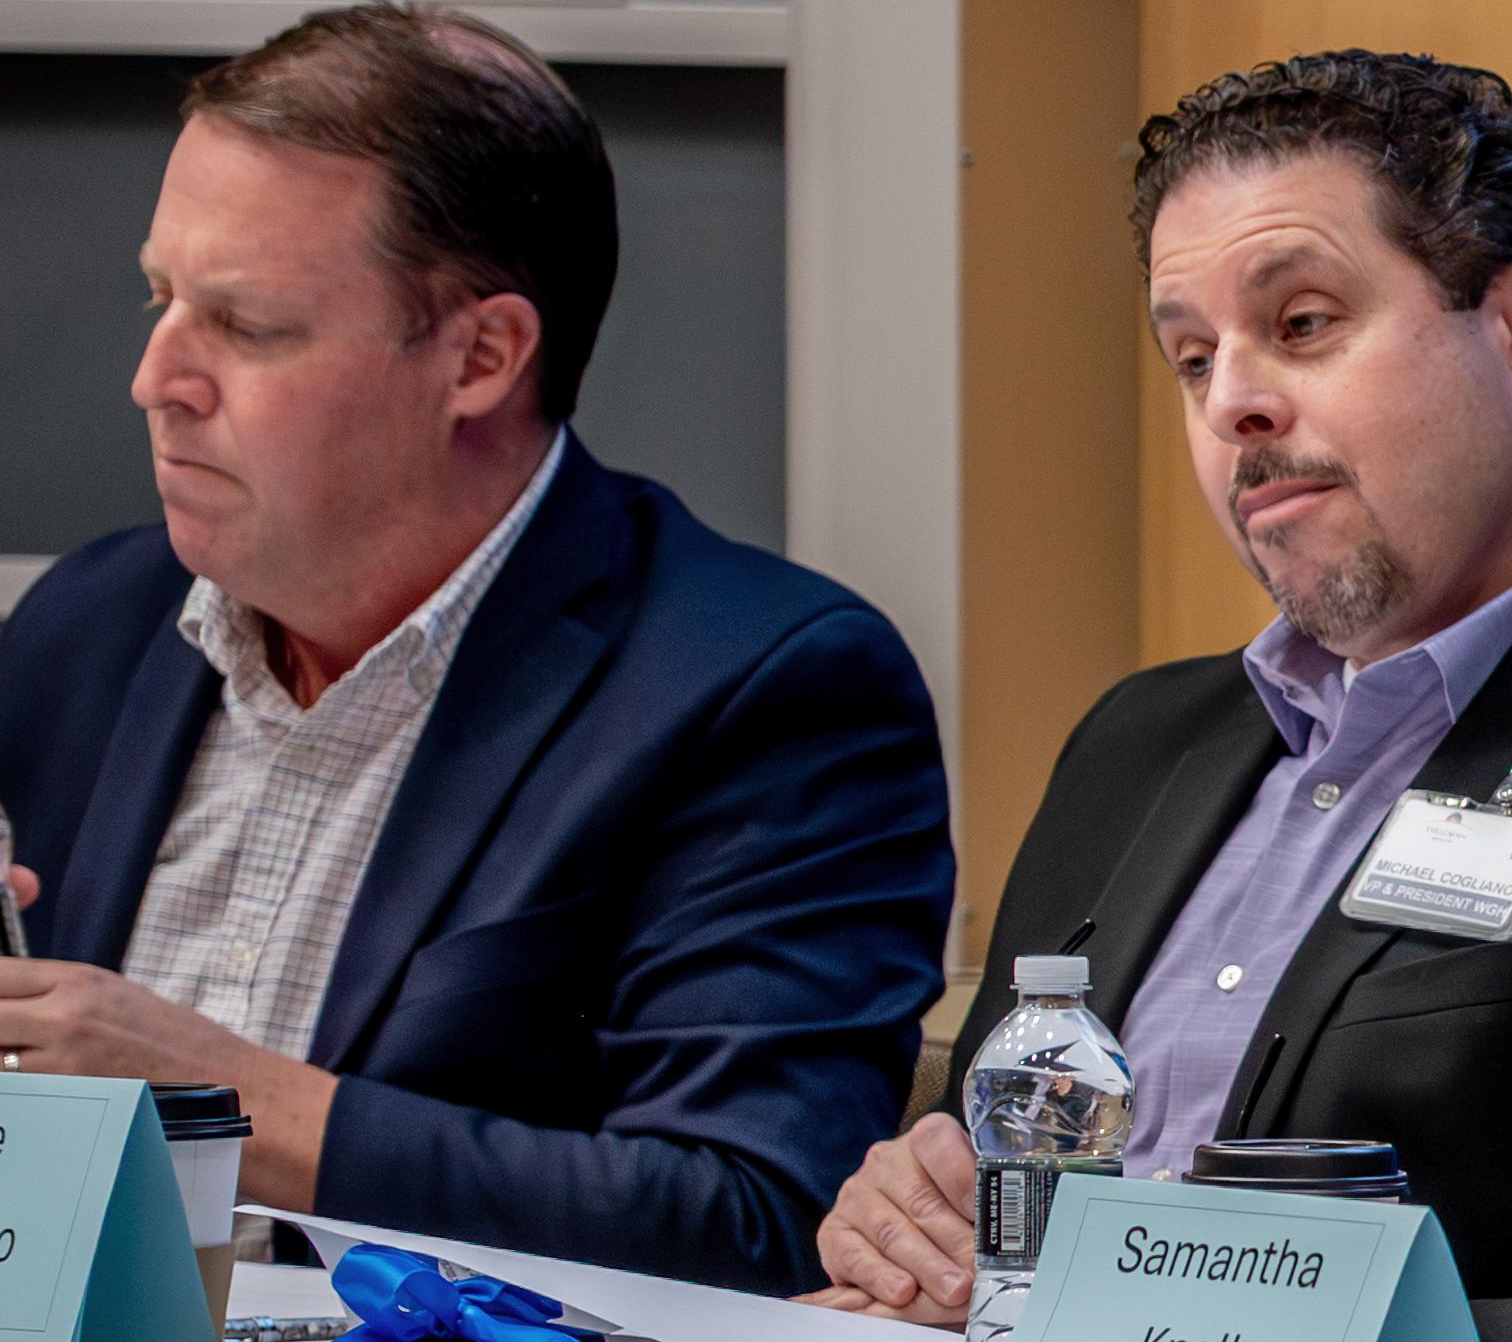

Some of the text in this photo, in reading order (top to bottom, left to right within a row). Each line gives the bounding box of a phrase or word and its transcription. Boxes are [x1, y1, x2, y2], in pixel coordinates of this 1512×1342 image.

[1375, 858, 1436, 881] MICHAEL
[1382, 882, 1393, 894] &
[1393, 883, 1474, 910] PRESIDENT
[1116, 1224, 1325, 1291] Samantha
